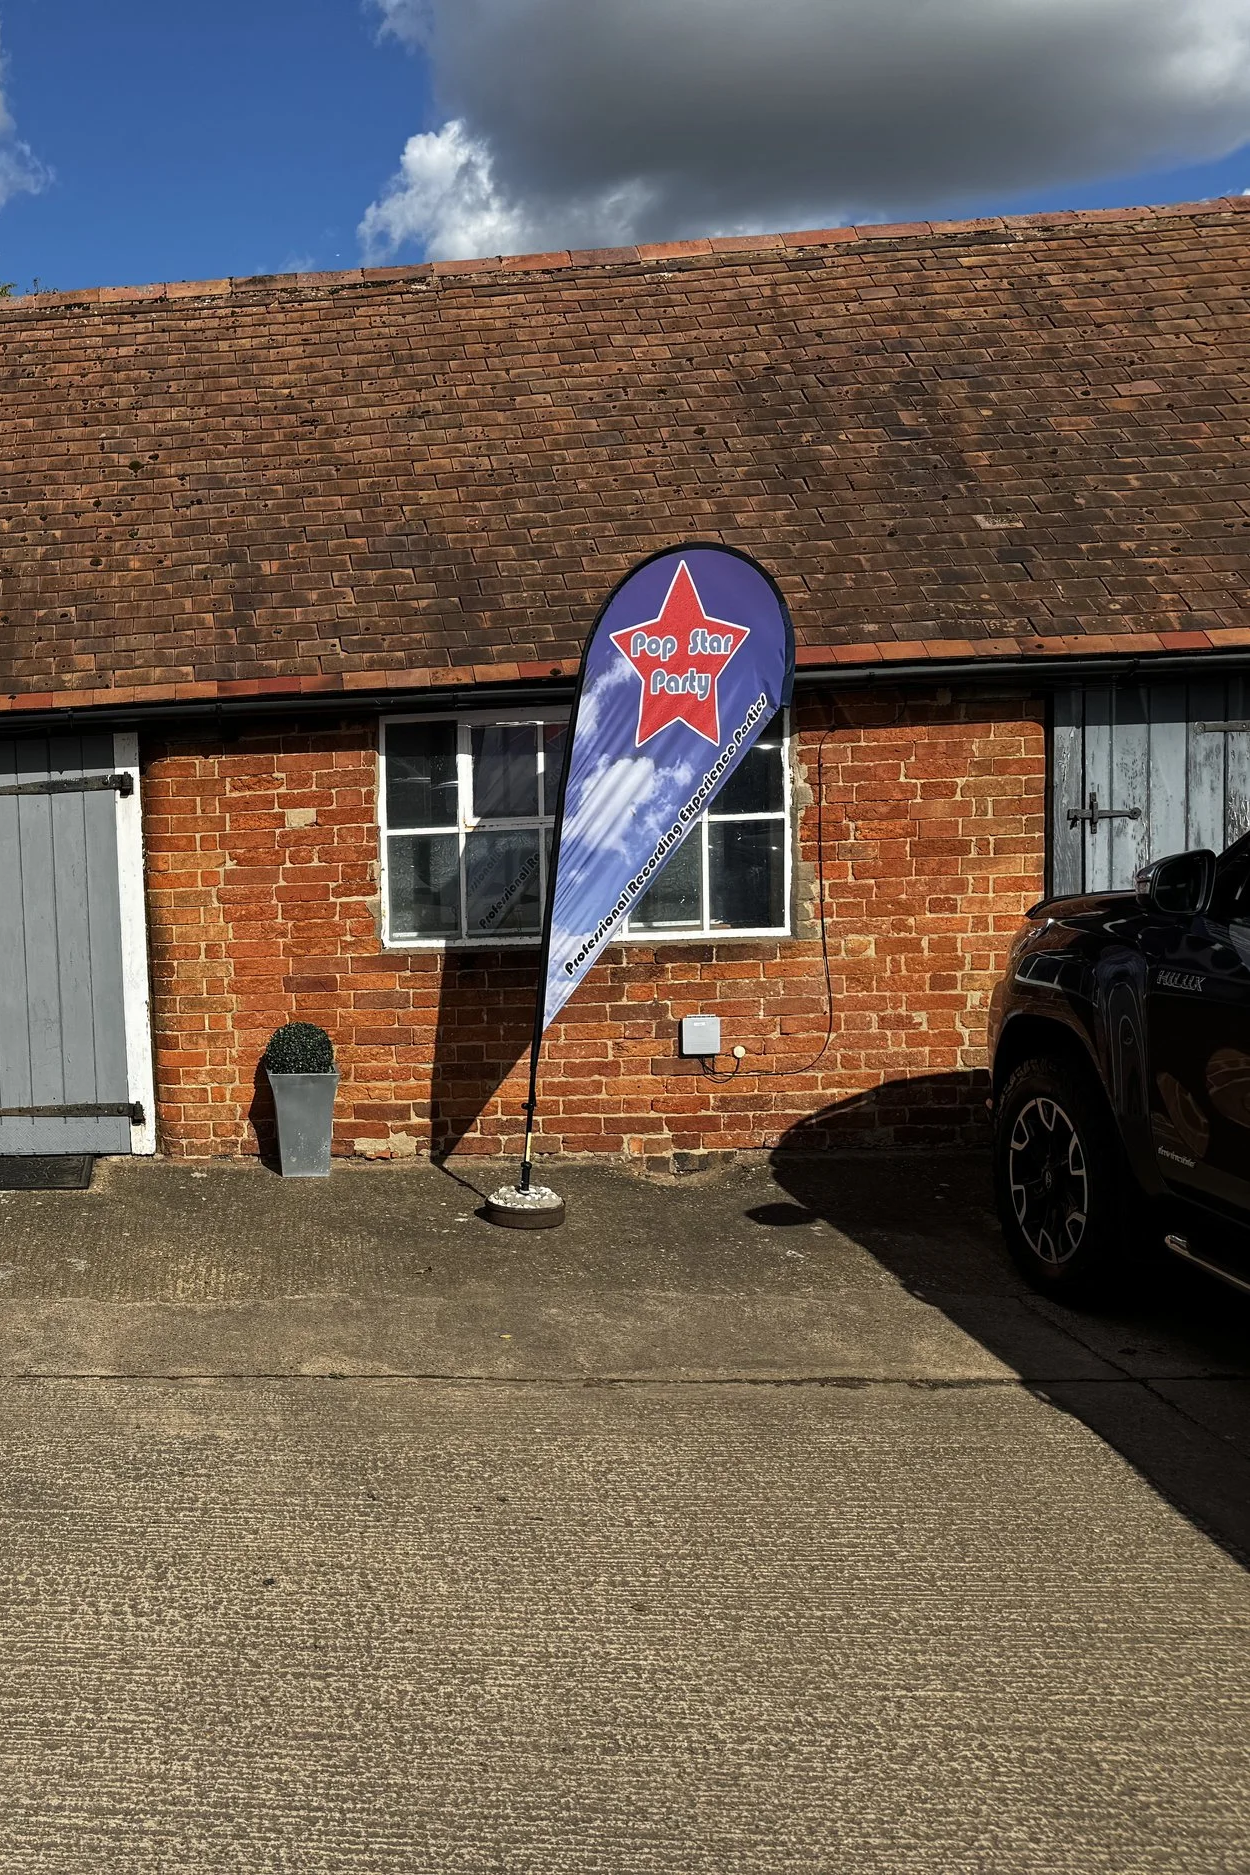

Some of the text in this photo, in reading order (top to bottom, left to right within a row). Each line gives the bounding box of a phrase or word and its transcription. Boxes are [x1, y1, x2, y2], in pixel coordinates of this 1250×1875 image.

[632, 629, 732, 660] Pop Star
[652, 669, 710, 700] Party
[564, 694, 766, 976] Professional Recording Experience Parties
[478, 864, 530, 929] Professional
[1157, 970, 1206, 992] HILUX
